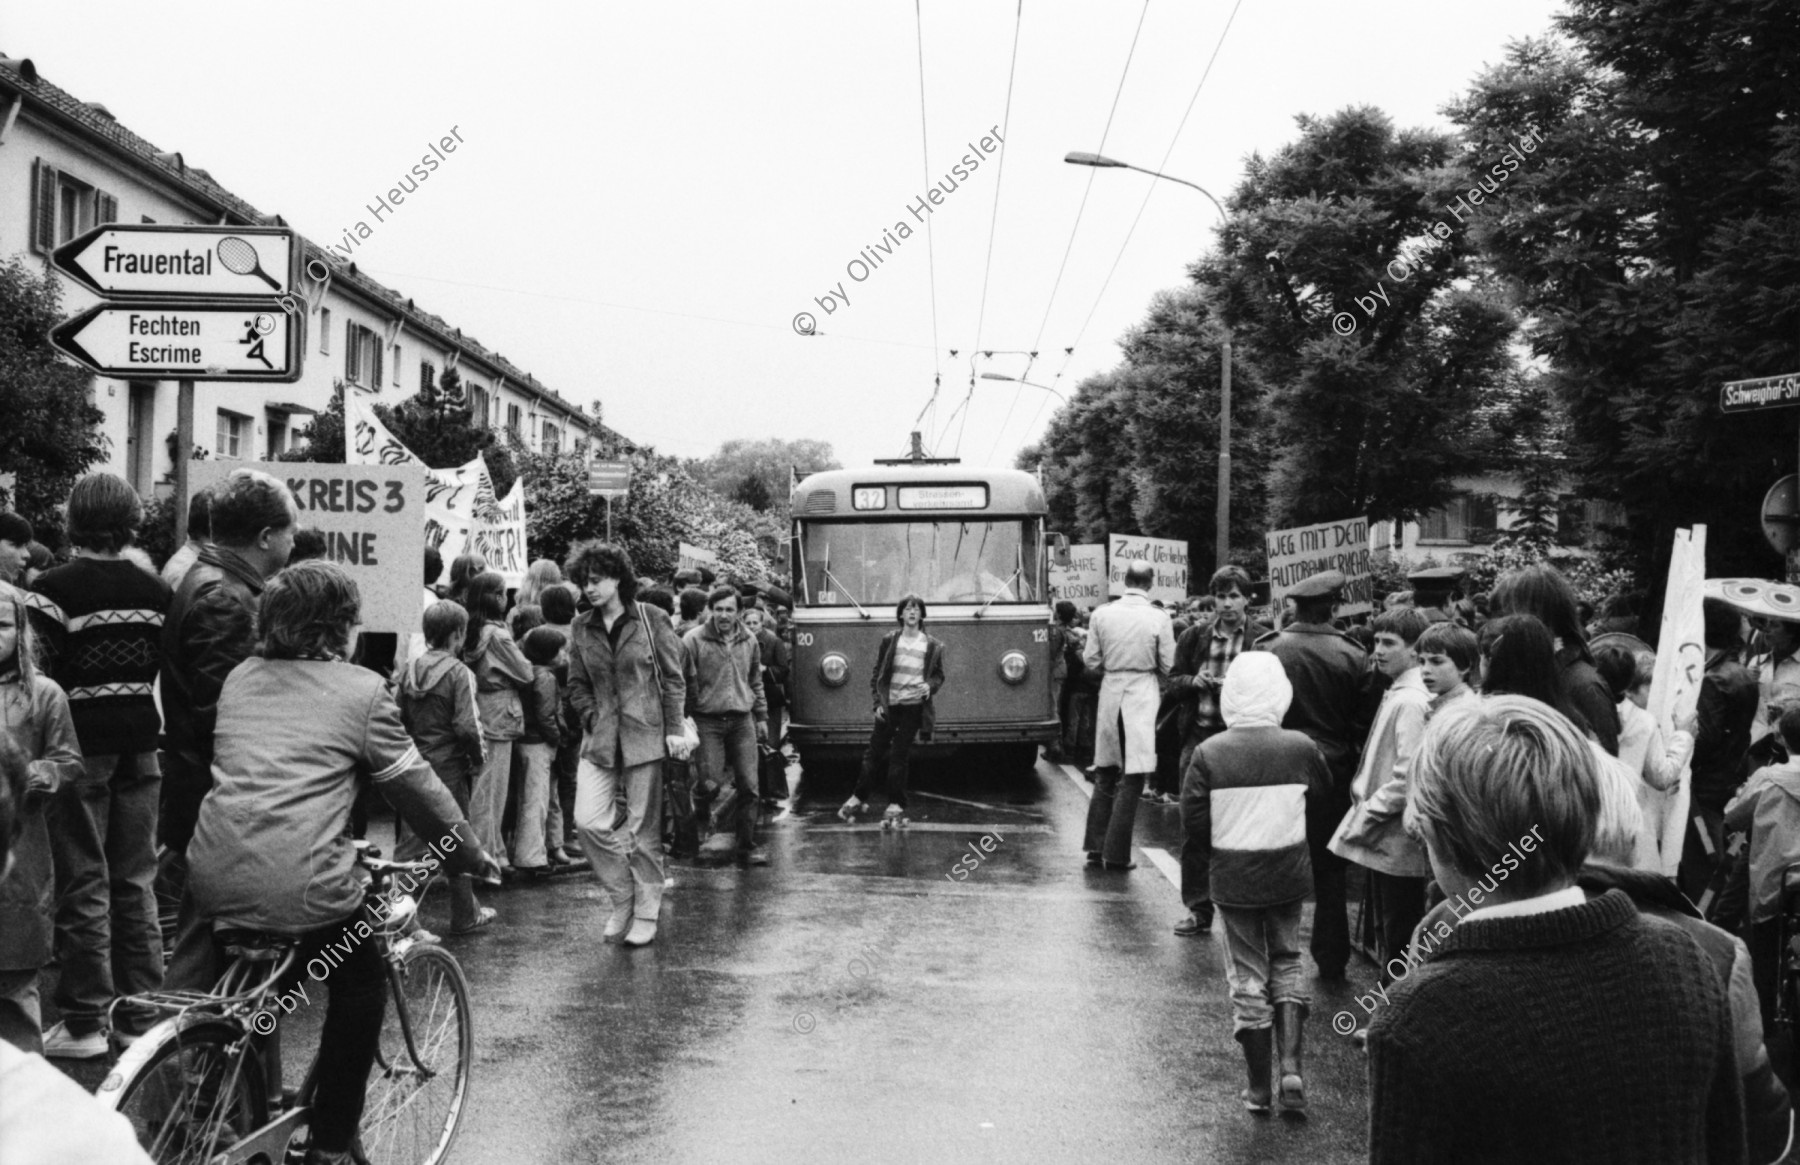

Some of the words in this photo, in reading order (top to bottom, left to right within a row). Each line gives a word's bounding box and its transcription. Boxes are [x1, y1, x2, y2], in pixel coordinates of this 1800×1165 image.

[104, 246, 212, 276] Frauental
[129, 314, 200, 336] Fechten
[129, 342, 202, 363] Escrime
[286, 478, 378, 513] KREIS
[383, 480, 405, 513] 3
[860, 490, 880, 509] 32
[1114, 540, 1150, 560] Zuviel
[1267, 534, 1296, 559] WEG
[1300, 528, 1330, 552] MIT
[1332, 521, 1367, 548] DEM
